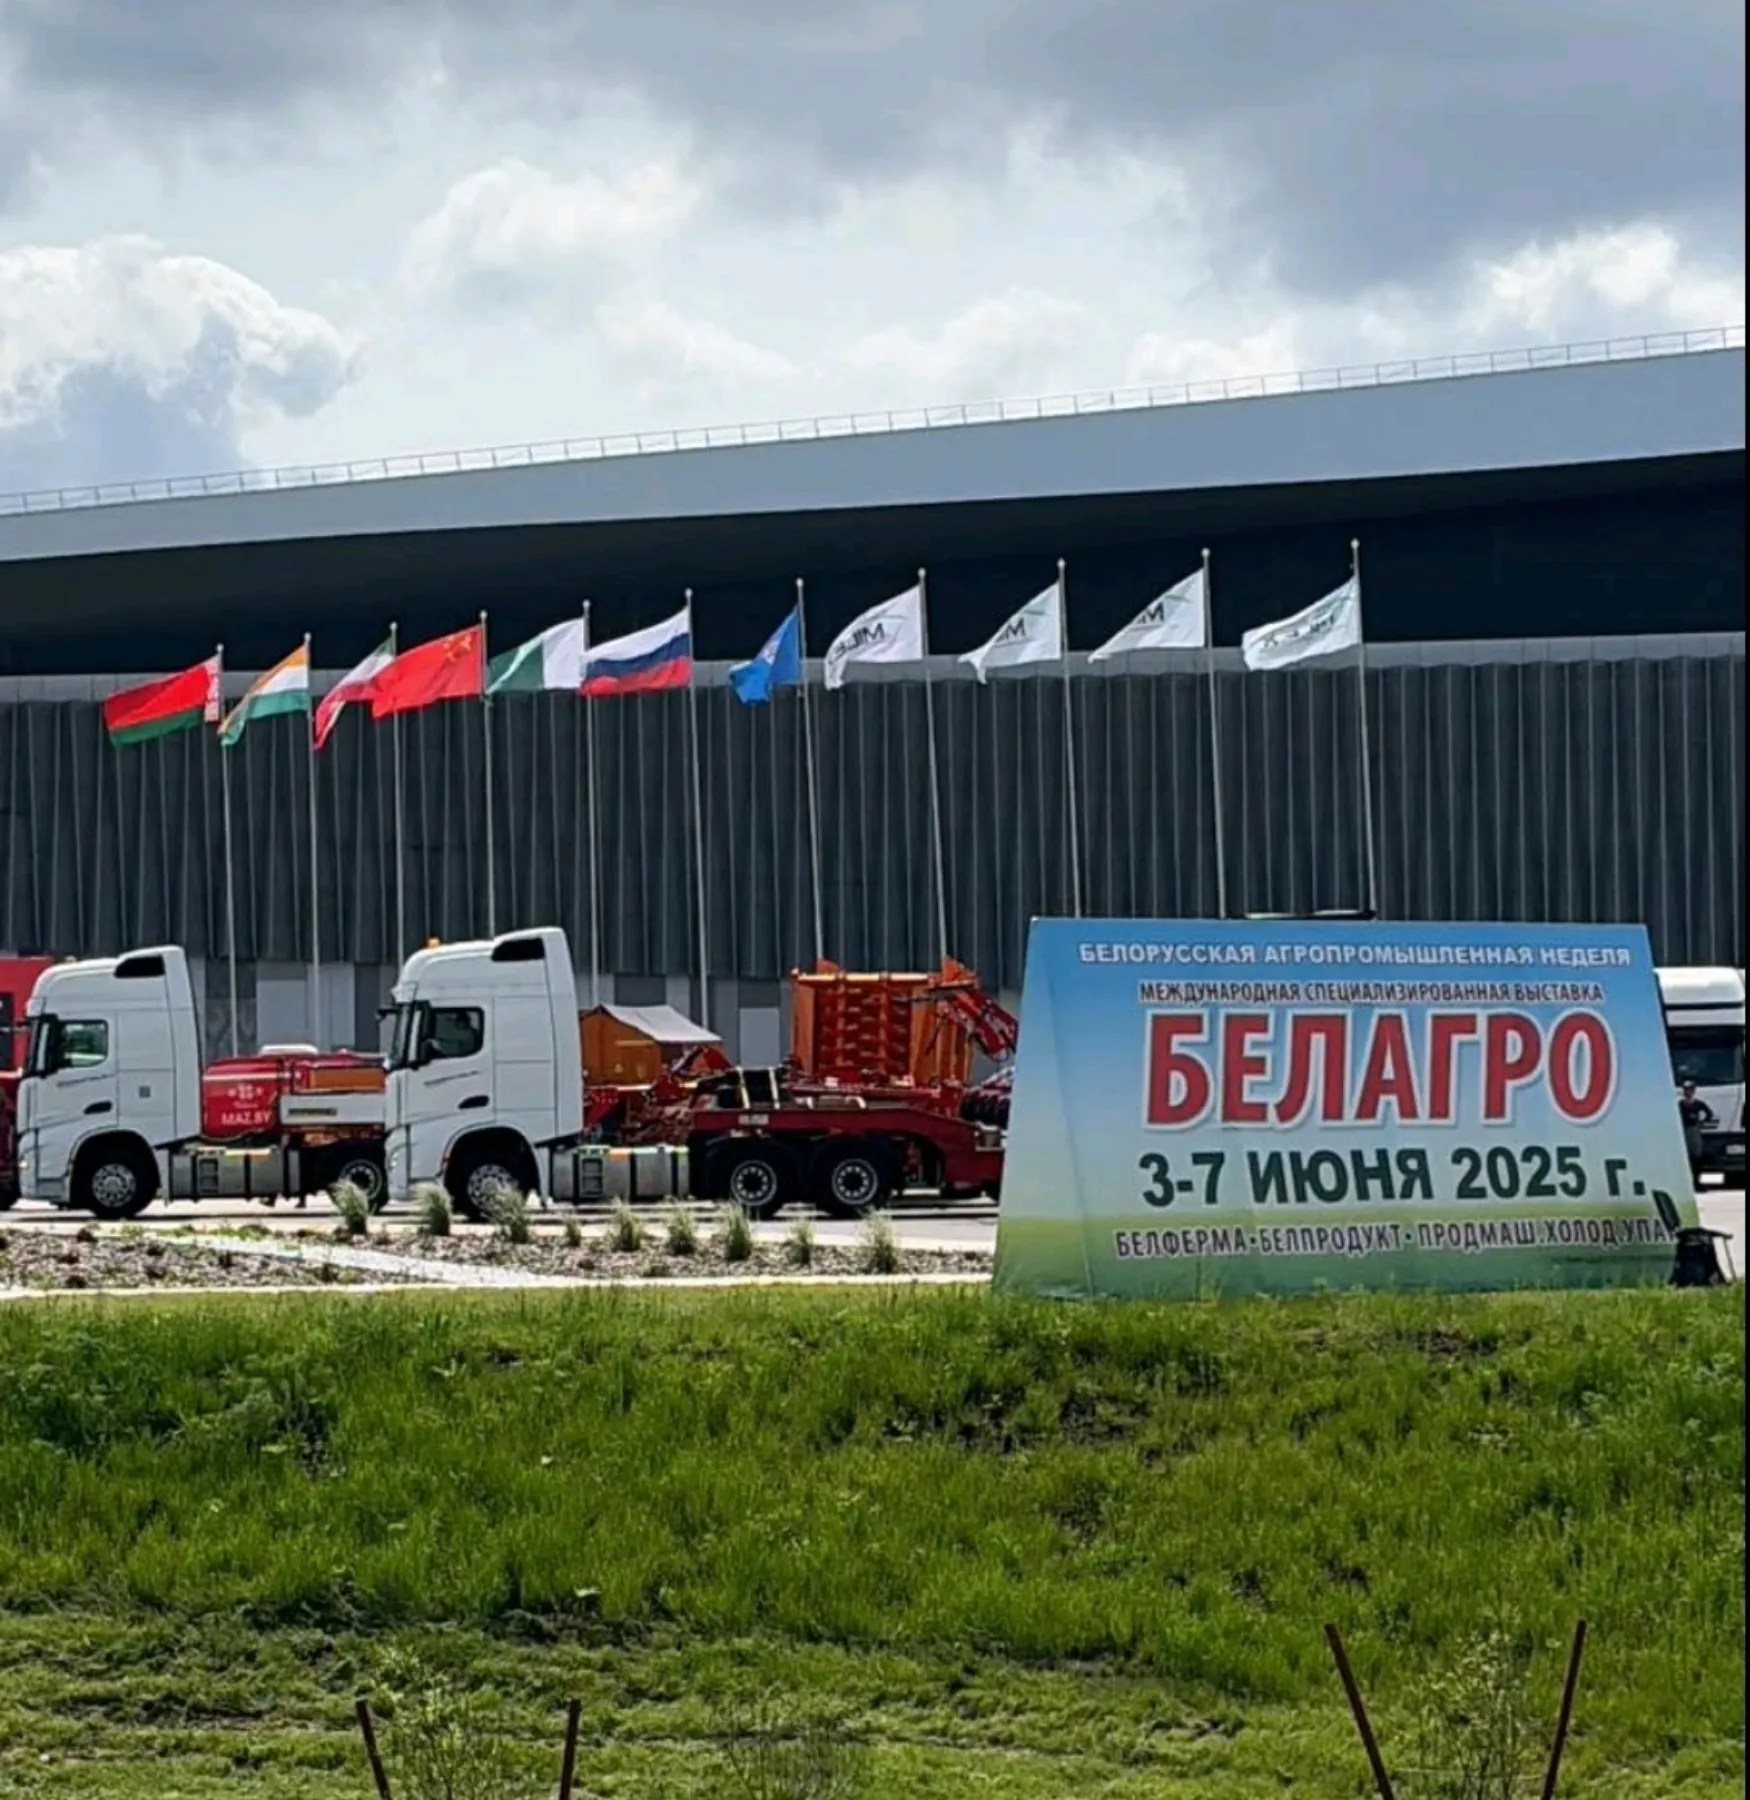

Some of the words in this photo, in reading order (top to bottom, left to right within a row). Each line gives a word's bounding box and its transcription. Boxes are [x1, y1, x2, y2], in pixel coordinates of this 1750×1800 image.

[1080, 943, 1255, 963] БЕЛОРУССКАЯ
[1264, 945, 1533, 965] АГРОПРОМЫШЛЕННАЯ
[1541, 948, 1631, 966] НЕДЕЛЯ
[1139, 982, 1301, 1003] МЕЖДУНАРОДНАЯ
[1303, 983, 1512, 1003] СПЕЦИАЛИЗИРОВАННАЯ
[1514, 983, 1603, 1001] ВЫСТАВКА
[1146, 1010, 1614, 1127] БЕЛАГРО
[1138, 1150, 1226, 1208] 3-7
[1246, 1148, 1434, 1205] ИЮНЯ
[1451, 1146, 1588, 1200] 2025
[1604, 1158, 1646, 1197] г.
